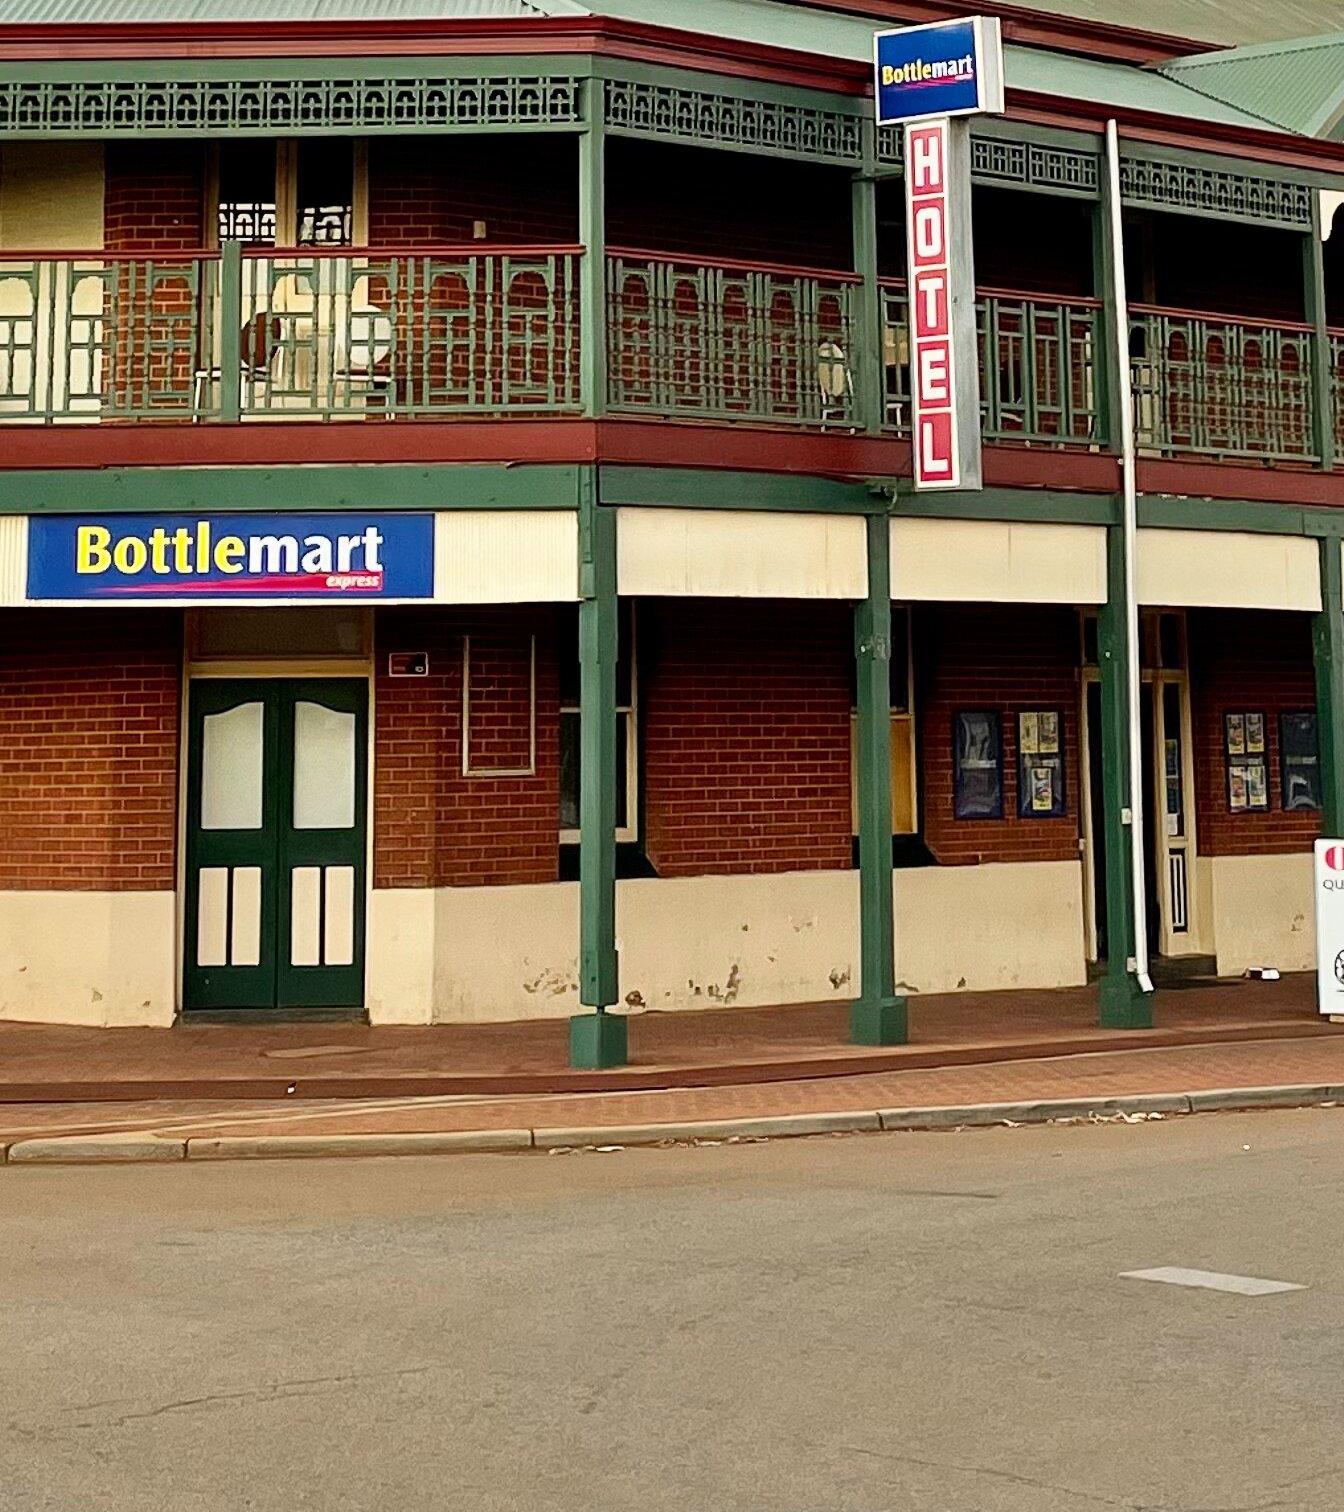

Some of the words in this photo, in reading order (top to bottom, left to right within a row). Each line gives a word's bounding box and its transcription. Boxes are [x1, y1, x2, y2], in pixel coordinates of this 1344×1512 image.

[882, 54, 973, 86] Bottlemart
[914, 137, 949, 474] HOTEL
[76, 521, 383, 573] Bottlemart
[326, 575, 379, 590] express
